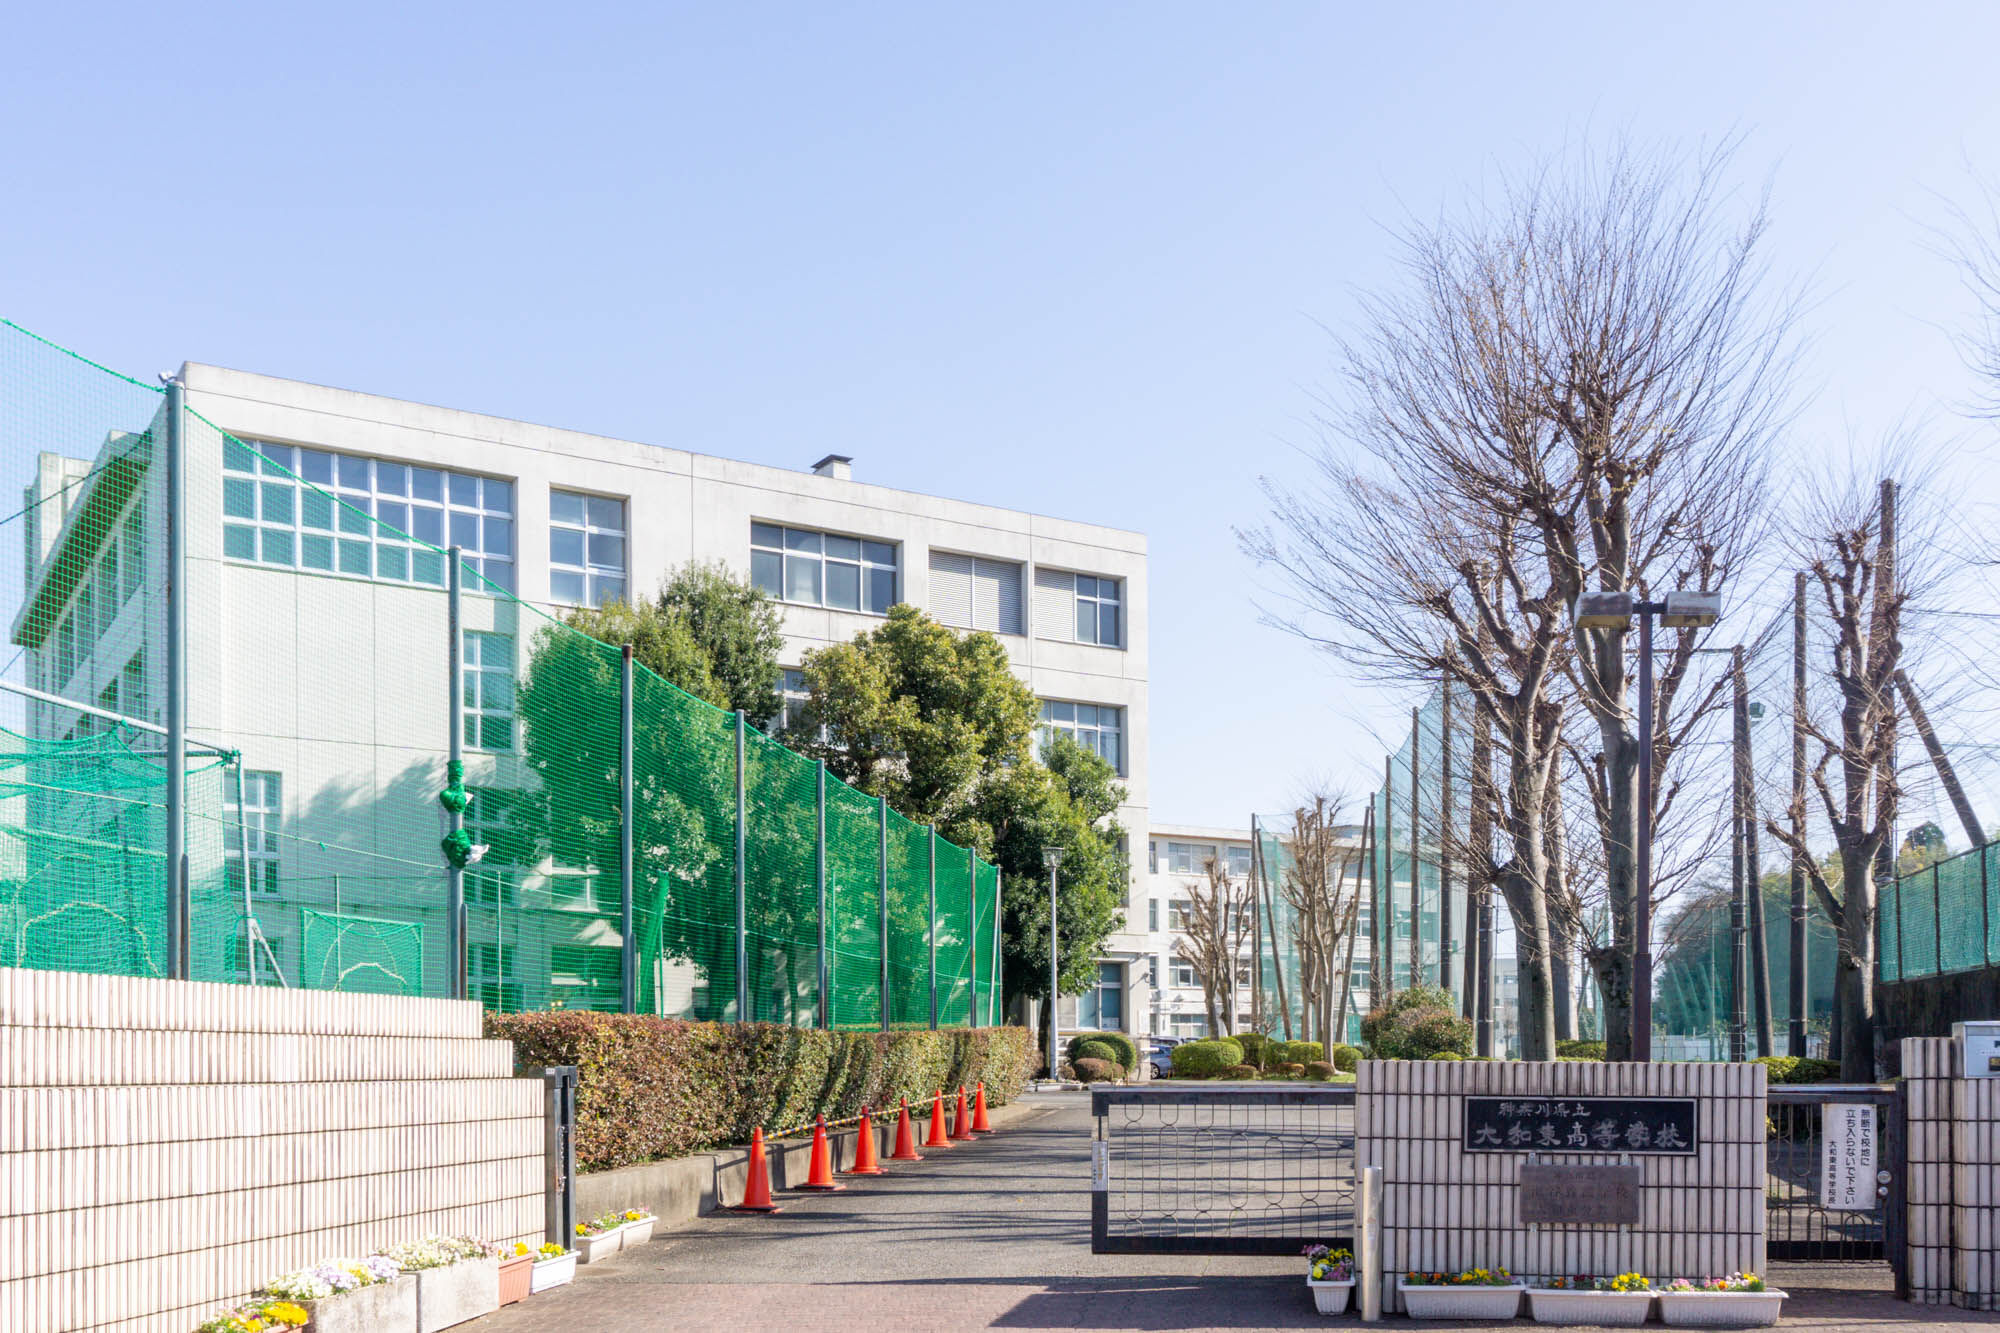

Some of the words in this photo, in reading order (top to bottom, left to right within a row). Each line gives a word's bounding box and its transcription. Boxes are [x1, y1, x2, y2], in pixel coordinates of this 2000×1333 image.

[1498, 1102, 1591, 1118] 神奈川県立
[1473, 1119, 1688, 1148] 大和東高等学校
[1860, 1109, 1871, 1166] 無断で校地に
[1845, 1109, 1856, 1205] 立ち入らないで下さい
